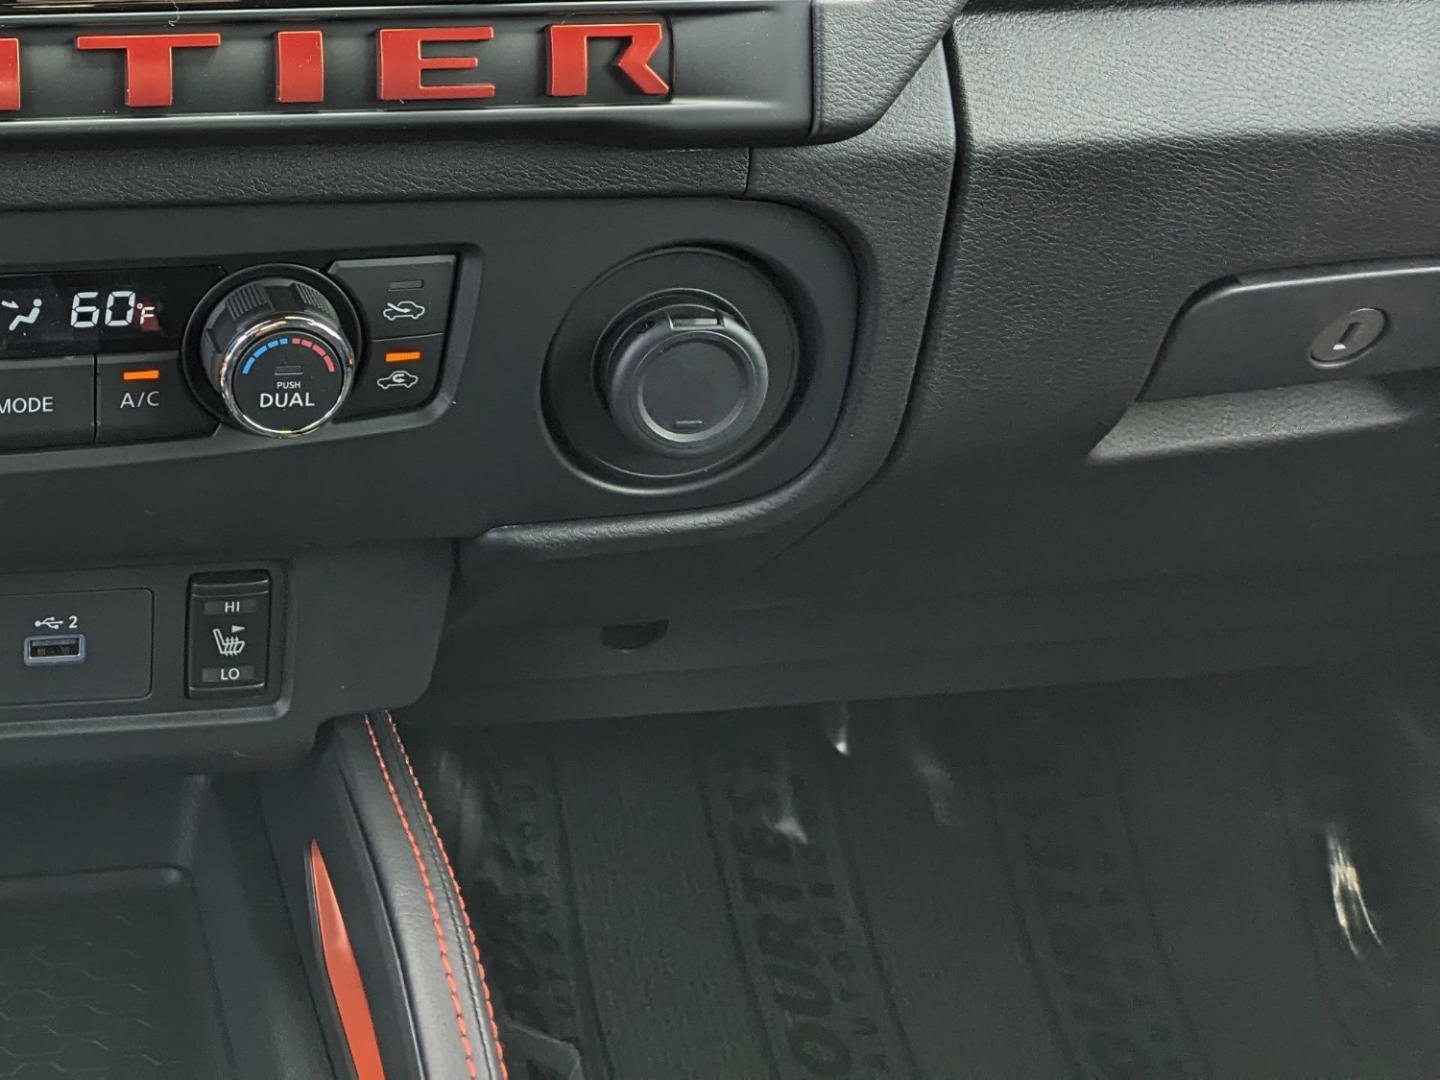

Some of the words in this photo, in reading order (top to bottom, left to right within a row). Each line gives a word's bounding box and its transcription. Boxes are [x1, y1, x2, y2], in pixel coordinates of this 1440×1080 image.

[276, 381, 301, 390] PUSH
[120, 391, 159, 408] A/C
[260, 392, 315, 408] DUAL
[224, 601, 240, 613] HI
[68, 616, 78, 629] 2
[220, 668, 240, 681] LO
